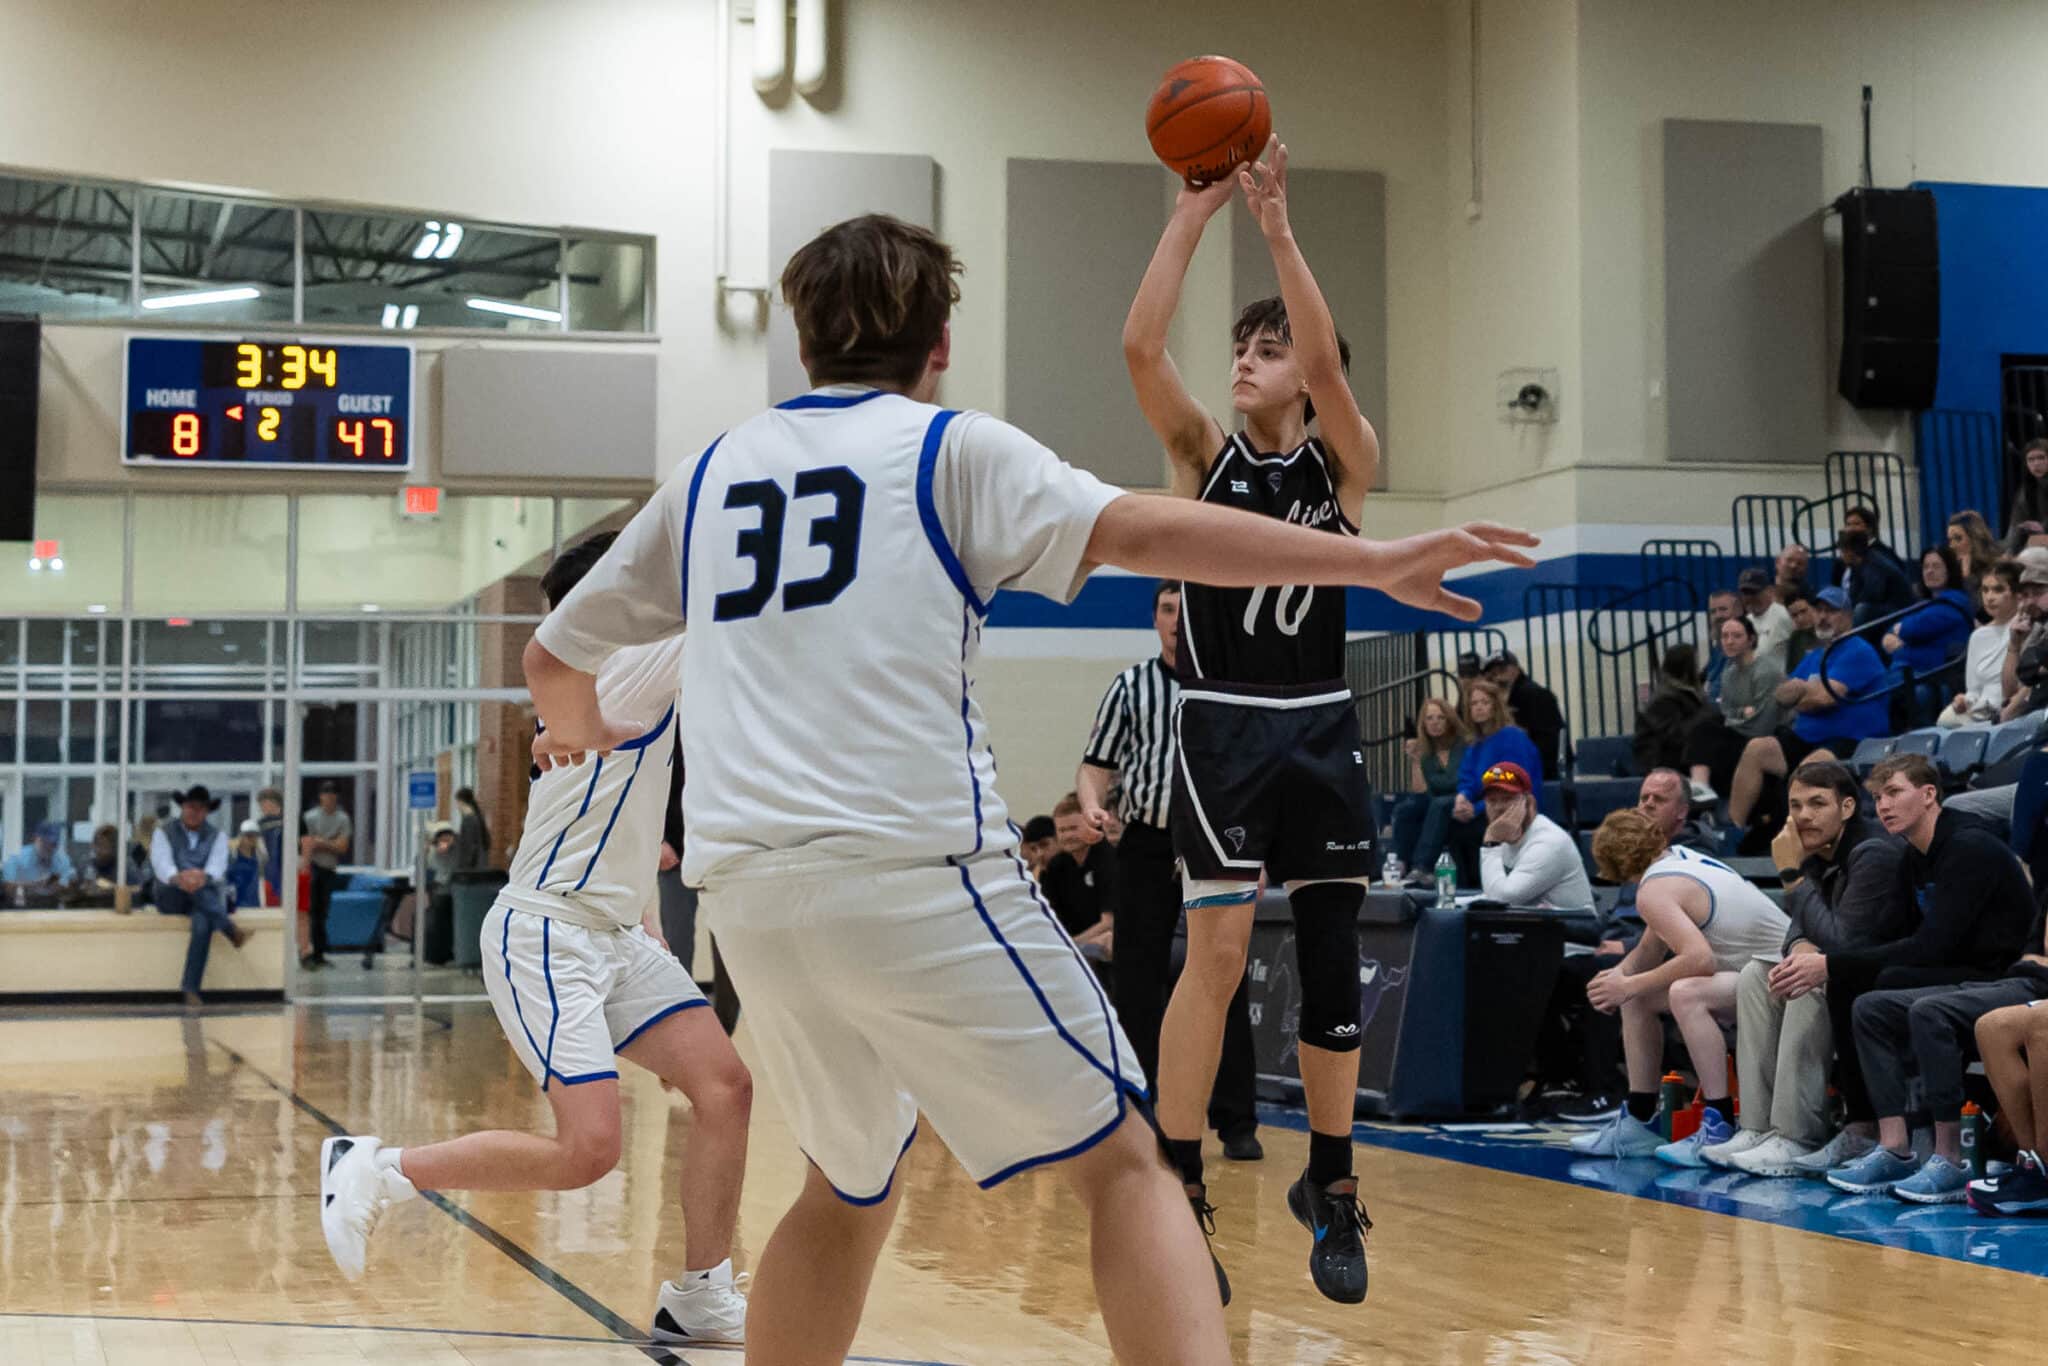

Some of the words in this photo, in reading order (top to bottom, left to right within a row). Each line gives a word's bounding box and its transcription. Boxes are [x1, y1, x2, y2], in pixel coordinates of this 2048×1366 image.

[236, 343, 338, 389] 3:34
[145, 389, 197, 408] HOME
[245, 391, 294, 406] PERIOD
[337, 394, 393, 414] GUEST
[172, 413, 199, 456] 8
[257, 407, 281, 441] 2
[337, 418, 394, 458] 47
[713, 465, 867, 622] 33
